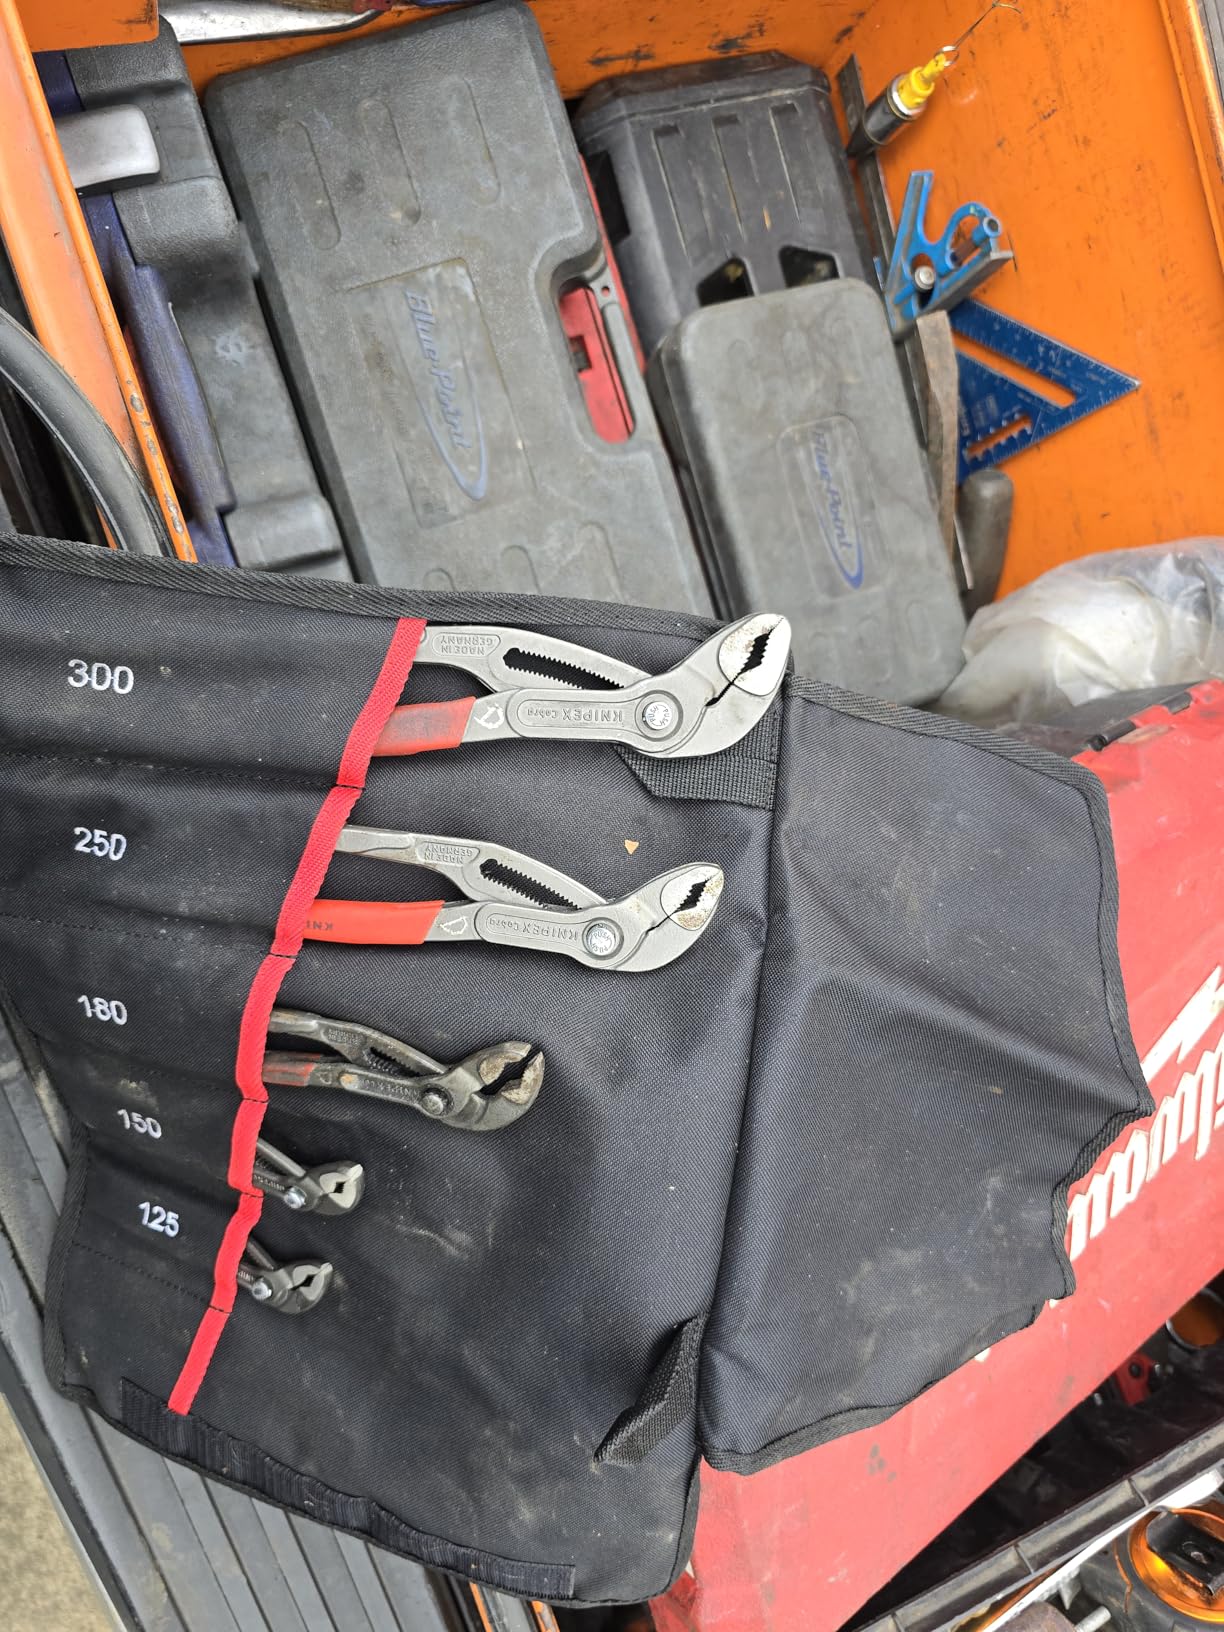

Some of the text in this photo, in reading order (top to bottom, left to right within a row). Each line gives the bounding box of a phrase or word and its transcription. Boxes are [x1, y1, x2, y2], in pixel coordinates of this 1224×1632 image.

[440, 635, 493, 647] GERMANY
[441, 644, 485, 656] MADE IN
[67, 658, 134, 694] 300
[527, 708, 623, 723] KNIPEX Cobra
[73, 826, 127, 861] 250
[425, 843, 473, 857] GERMANY
[306, 920, 334, 931] KNI
[489, 917, 579, 941] KNIPEX Cobra
[77, 994, 128, 1026] 180
[117, 1108, 162, 1139] 150
[138, 1201, 180, 1238] 125
